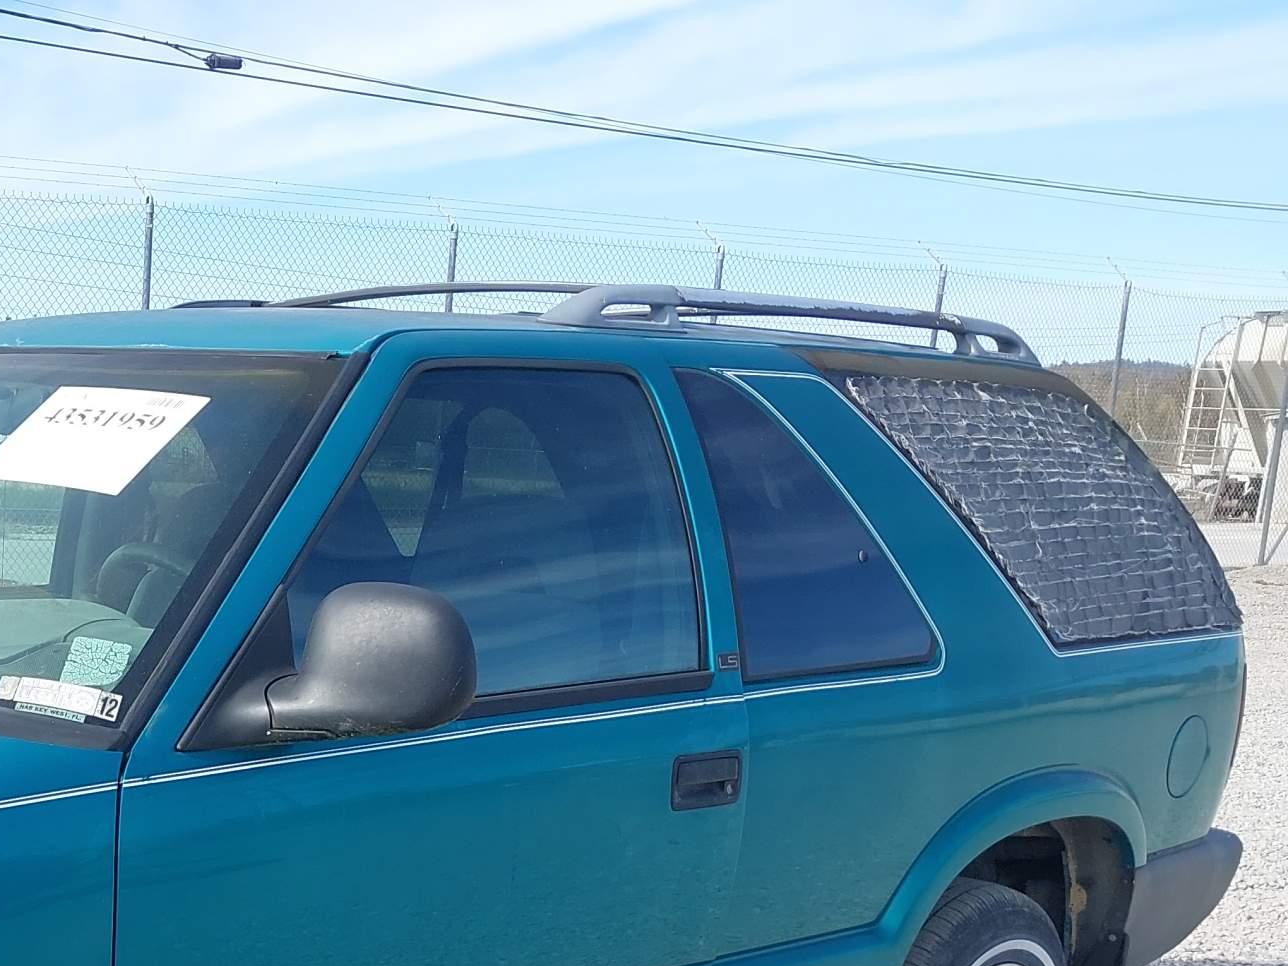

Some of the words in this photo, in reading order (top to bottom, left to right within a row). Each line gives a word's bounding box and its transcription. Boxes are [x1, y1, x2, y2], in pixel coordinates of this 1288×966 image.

[44, 407, 167, 431] 43531959
[718, 655, 739, 669] LS
[100, 694, 119, 719] 12
